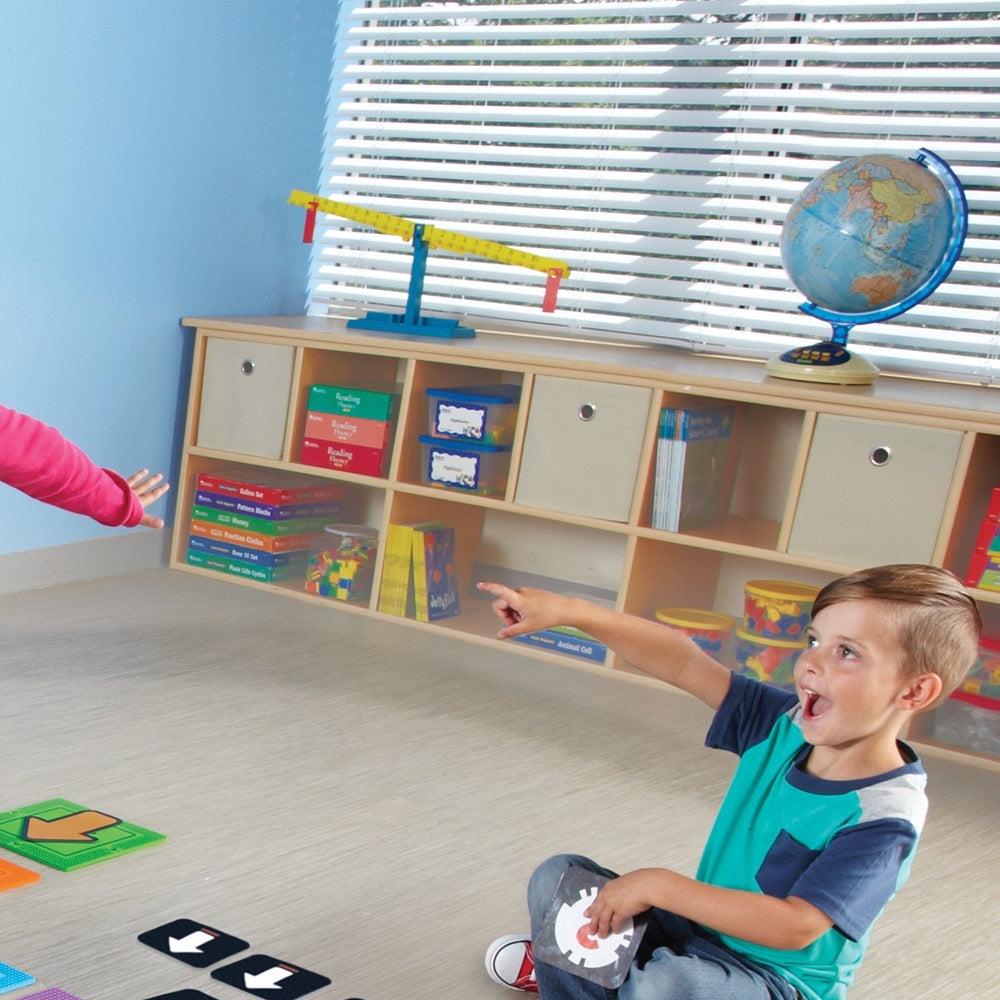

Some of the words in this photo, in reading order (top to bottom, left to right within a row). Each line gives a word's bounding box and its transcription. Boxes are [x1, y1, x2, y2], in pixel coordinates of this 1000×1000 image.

[336, 392, 361, 404] Reading
[332, 420, 358, 433] Reading
[328, 446, 353, 460] Reading
[255, 491, 263, 499] Set
[237, 503, 255, 513] Pattern
[255, 507, 271, 517] Blocks
[224, 529, 246, 542] Fraction
[232, 549, 243, 558] Base
[244, 551, 250, 559] 10
[229, 564, 241, 573] Plant
[557, 640, 580, 651] Animal
[581, 645, 592, 655] Cell
